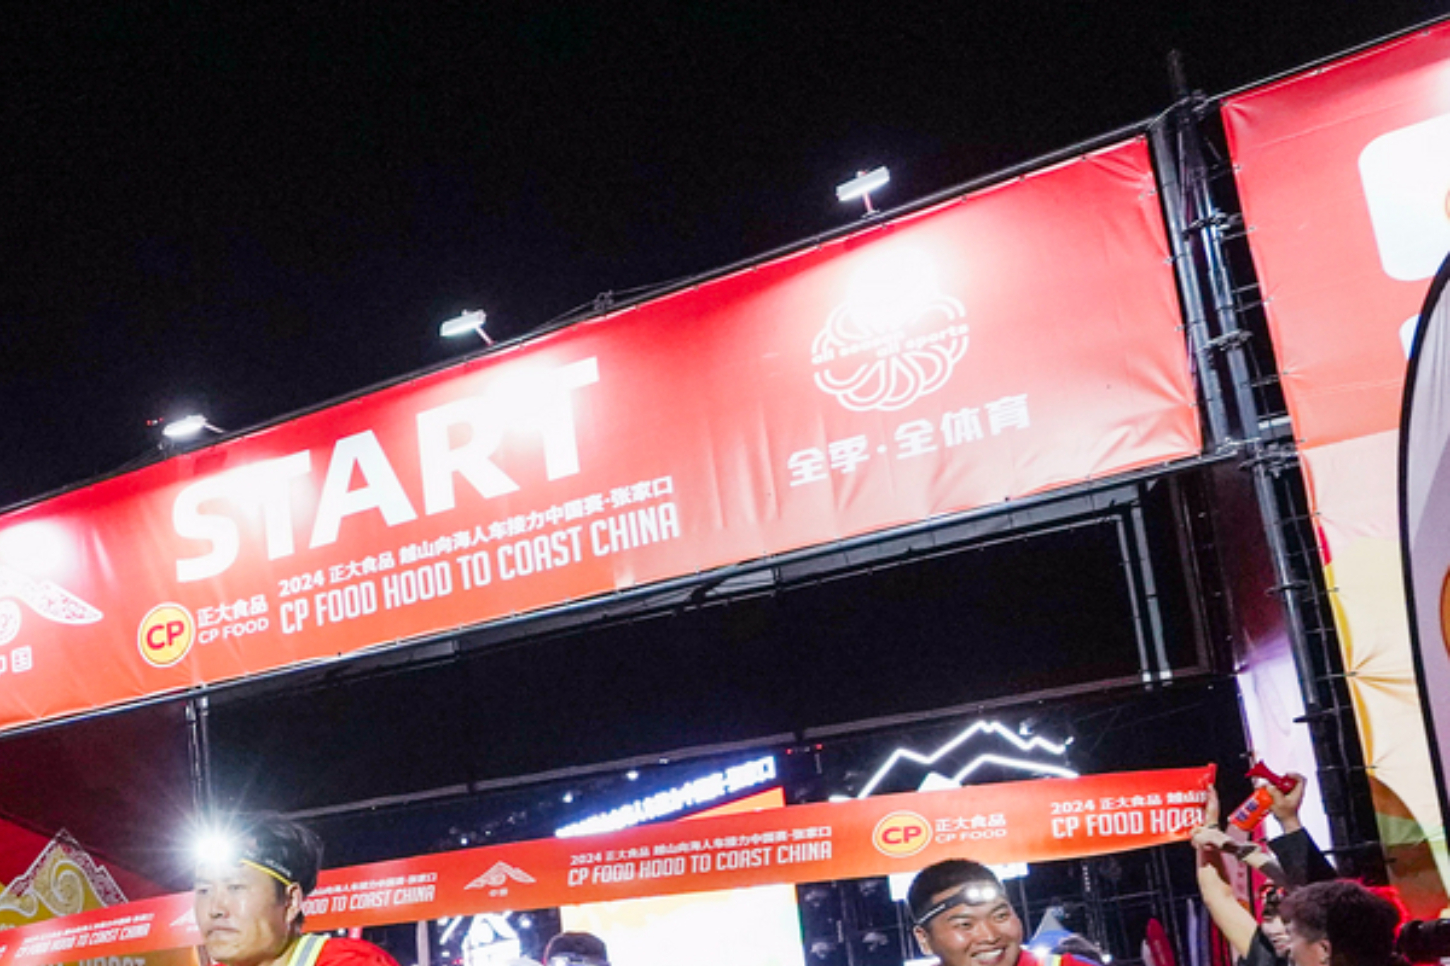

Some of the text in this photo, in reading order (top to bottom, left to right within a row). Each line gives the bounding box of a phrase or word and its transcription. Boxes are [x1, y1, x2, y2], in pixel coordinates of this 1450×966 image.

[174, 357, 601, 583] START
[278, 570, 325, 598] 2024
[329, 550, 396, 584] 正大食品
[280, 501, 681, 634] CP FOOD HOOD TO COAST CHINA
[197, 594, 269, 628] 正大食品
[145, 620, 186, 650] CP
[198, 617, 270, 644] CP FOOD
[1051, 800, 1095, 815] 2024
[881, 826, 923, 844] CP
[935, 814, 1006, 833] 正大食品
[935, 828, 1007, 843] CP FOOD
[1052, 817, 1081, 839] CP
[1087, 811, 1144, 837] FOOD
[567, 841, 833, 886] CP FOOD HOOD TO COAST CHINA
